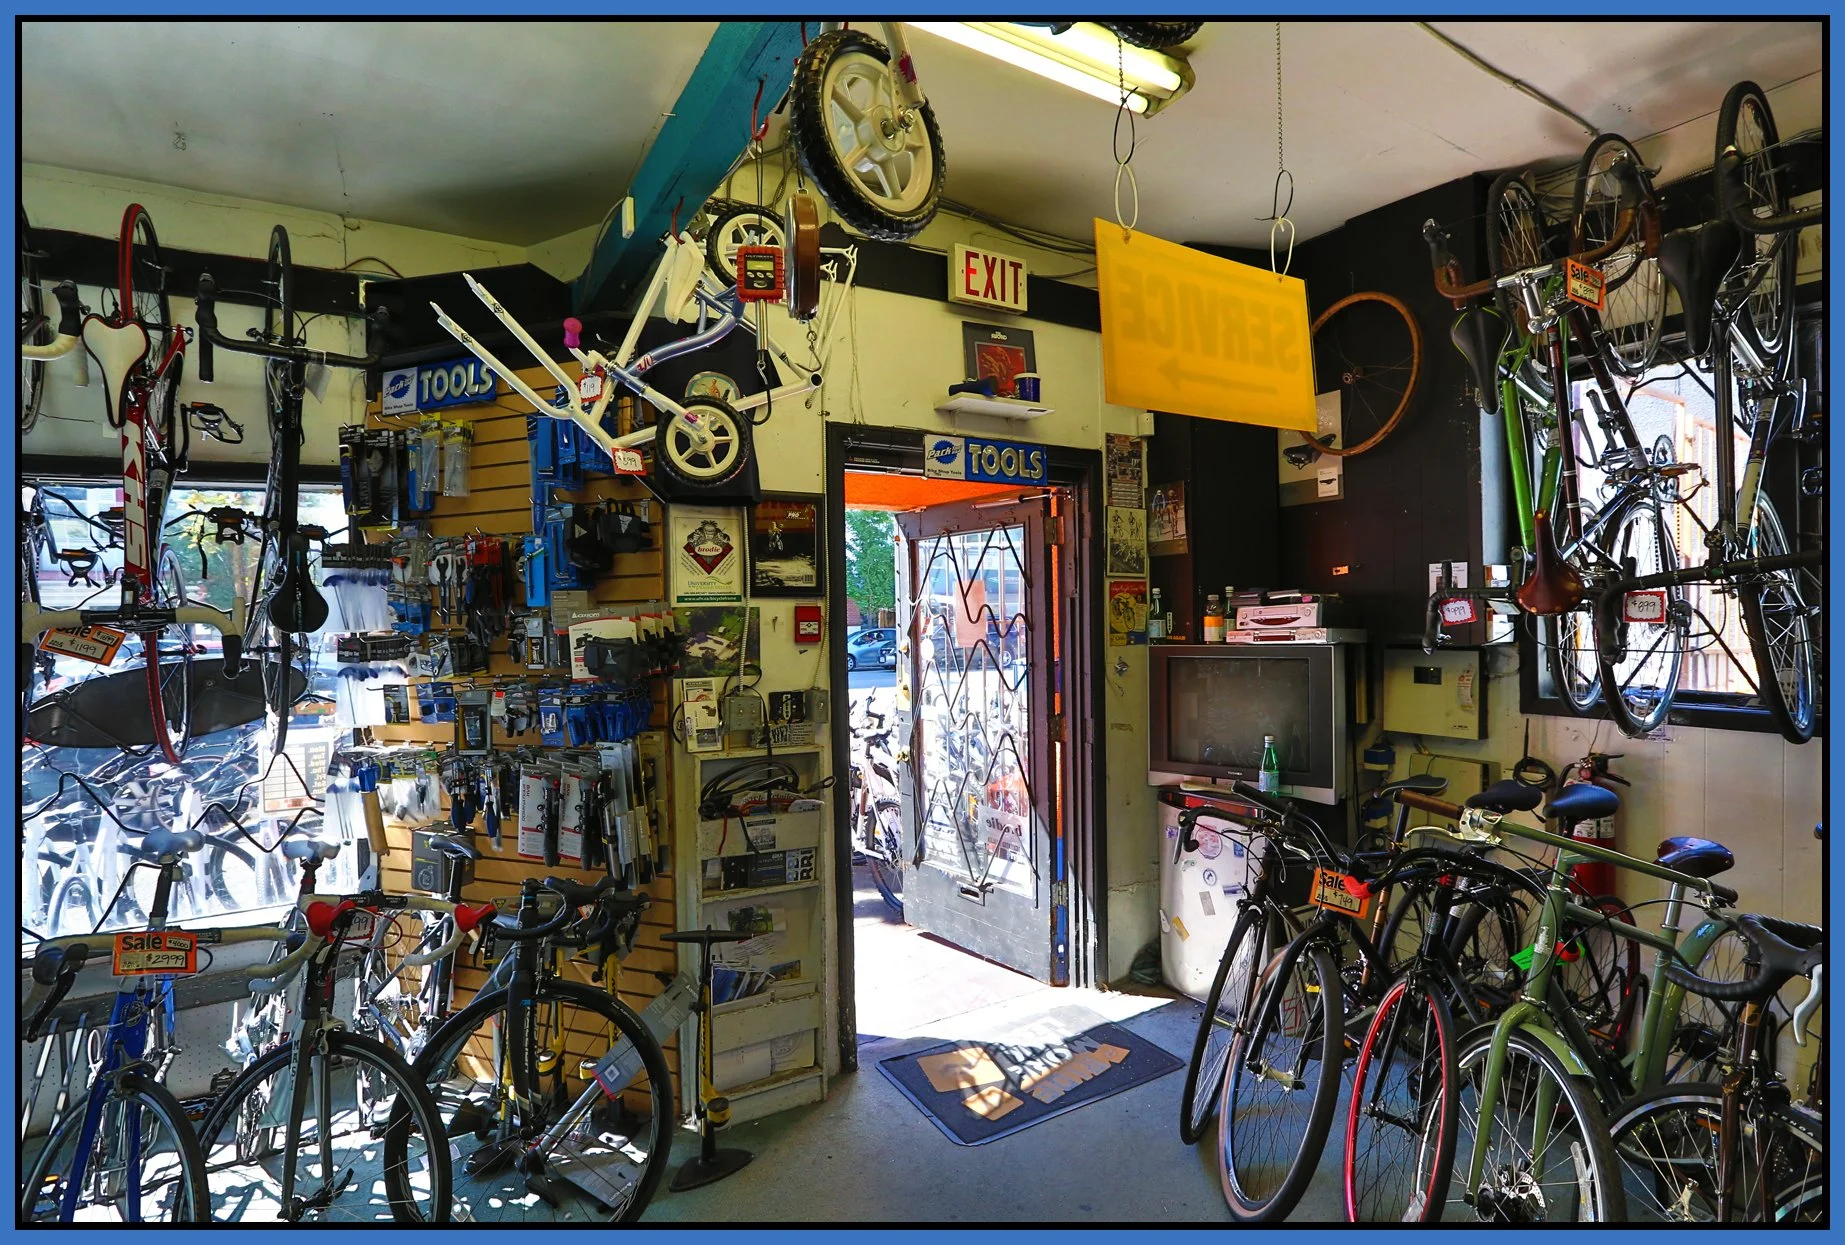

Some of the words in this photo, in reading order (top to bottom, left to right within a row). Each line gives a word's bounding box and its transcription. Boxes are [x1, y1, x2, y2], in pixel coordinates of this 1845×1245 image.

[965, 250, 1022, 305] EXIT
[1571, 264, 1589, 282] Sale
[420, 362, 493, 403] TOOLS
[927, 447, 952, 460] Park
[968, 443, 1043, 479] TOOLS
[1632, 600, 1656, 612] $899
[70, 638, 97, 655] $1199
[1319, 872, 1345, 890] Sale
[122, 933, 162, 950] Sale
[168, 939, 189, 949] $4000
[146, 953, 184, 966] $2999
